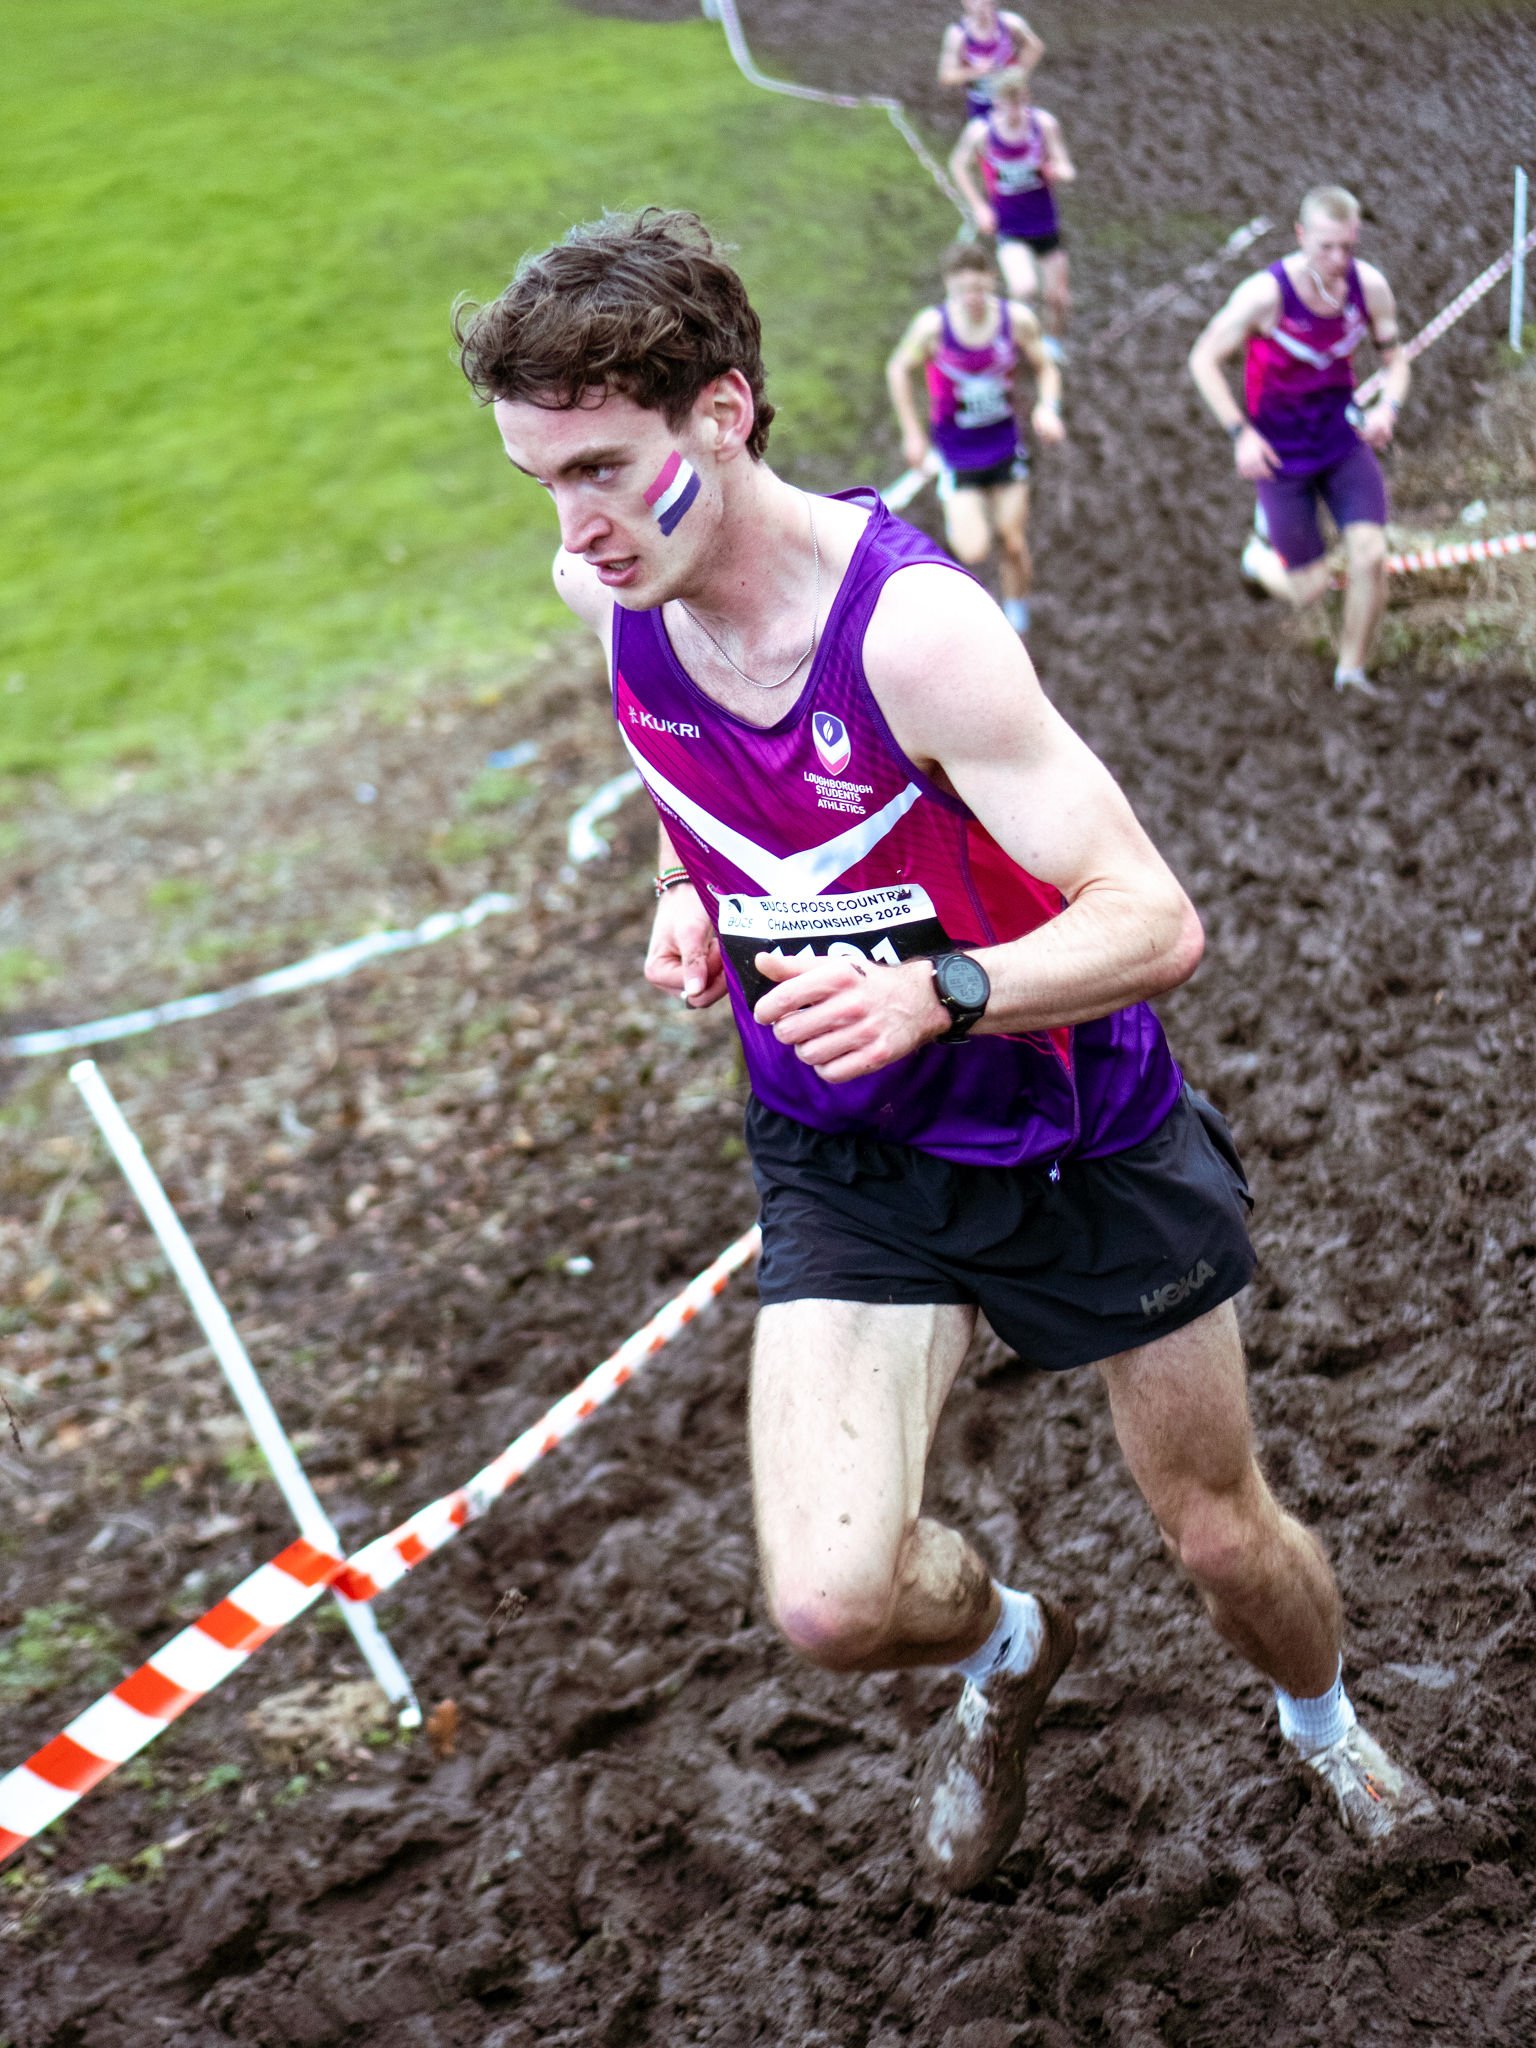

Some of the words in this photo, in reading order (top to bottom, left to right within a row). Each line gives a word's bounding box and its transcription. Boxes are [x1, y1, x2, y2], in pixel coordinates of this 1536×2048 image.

[639, 711, 701, 738] KUKRI
[803, 771, 874, 794] LOUGHBOROUGH
[815, 785, 862, 802] STUDENTS
[817, 798, 866, 815] ATHLETICS
[760, 901, 789, 913] BUCS
[791, 901, 834, 914] CROSS
[767, 913, 873, 931] CHAMPIONSHIPS
[875, 904, 911, 921] 2026
[1140, 1259, 1217, 1316] HOKA
